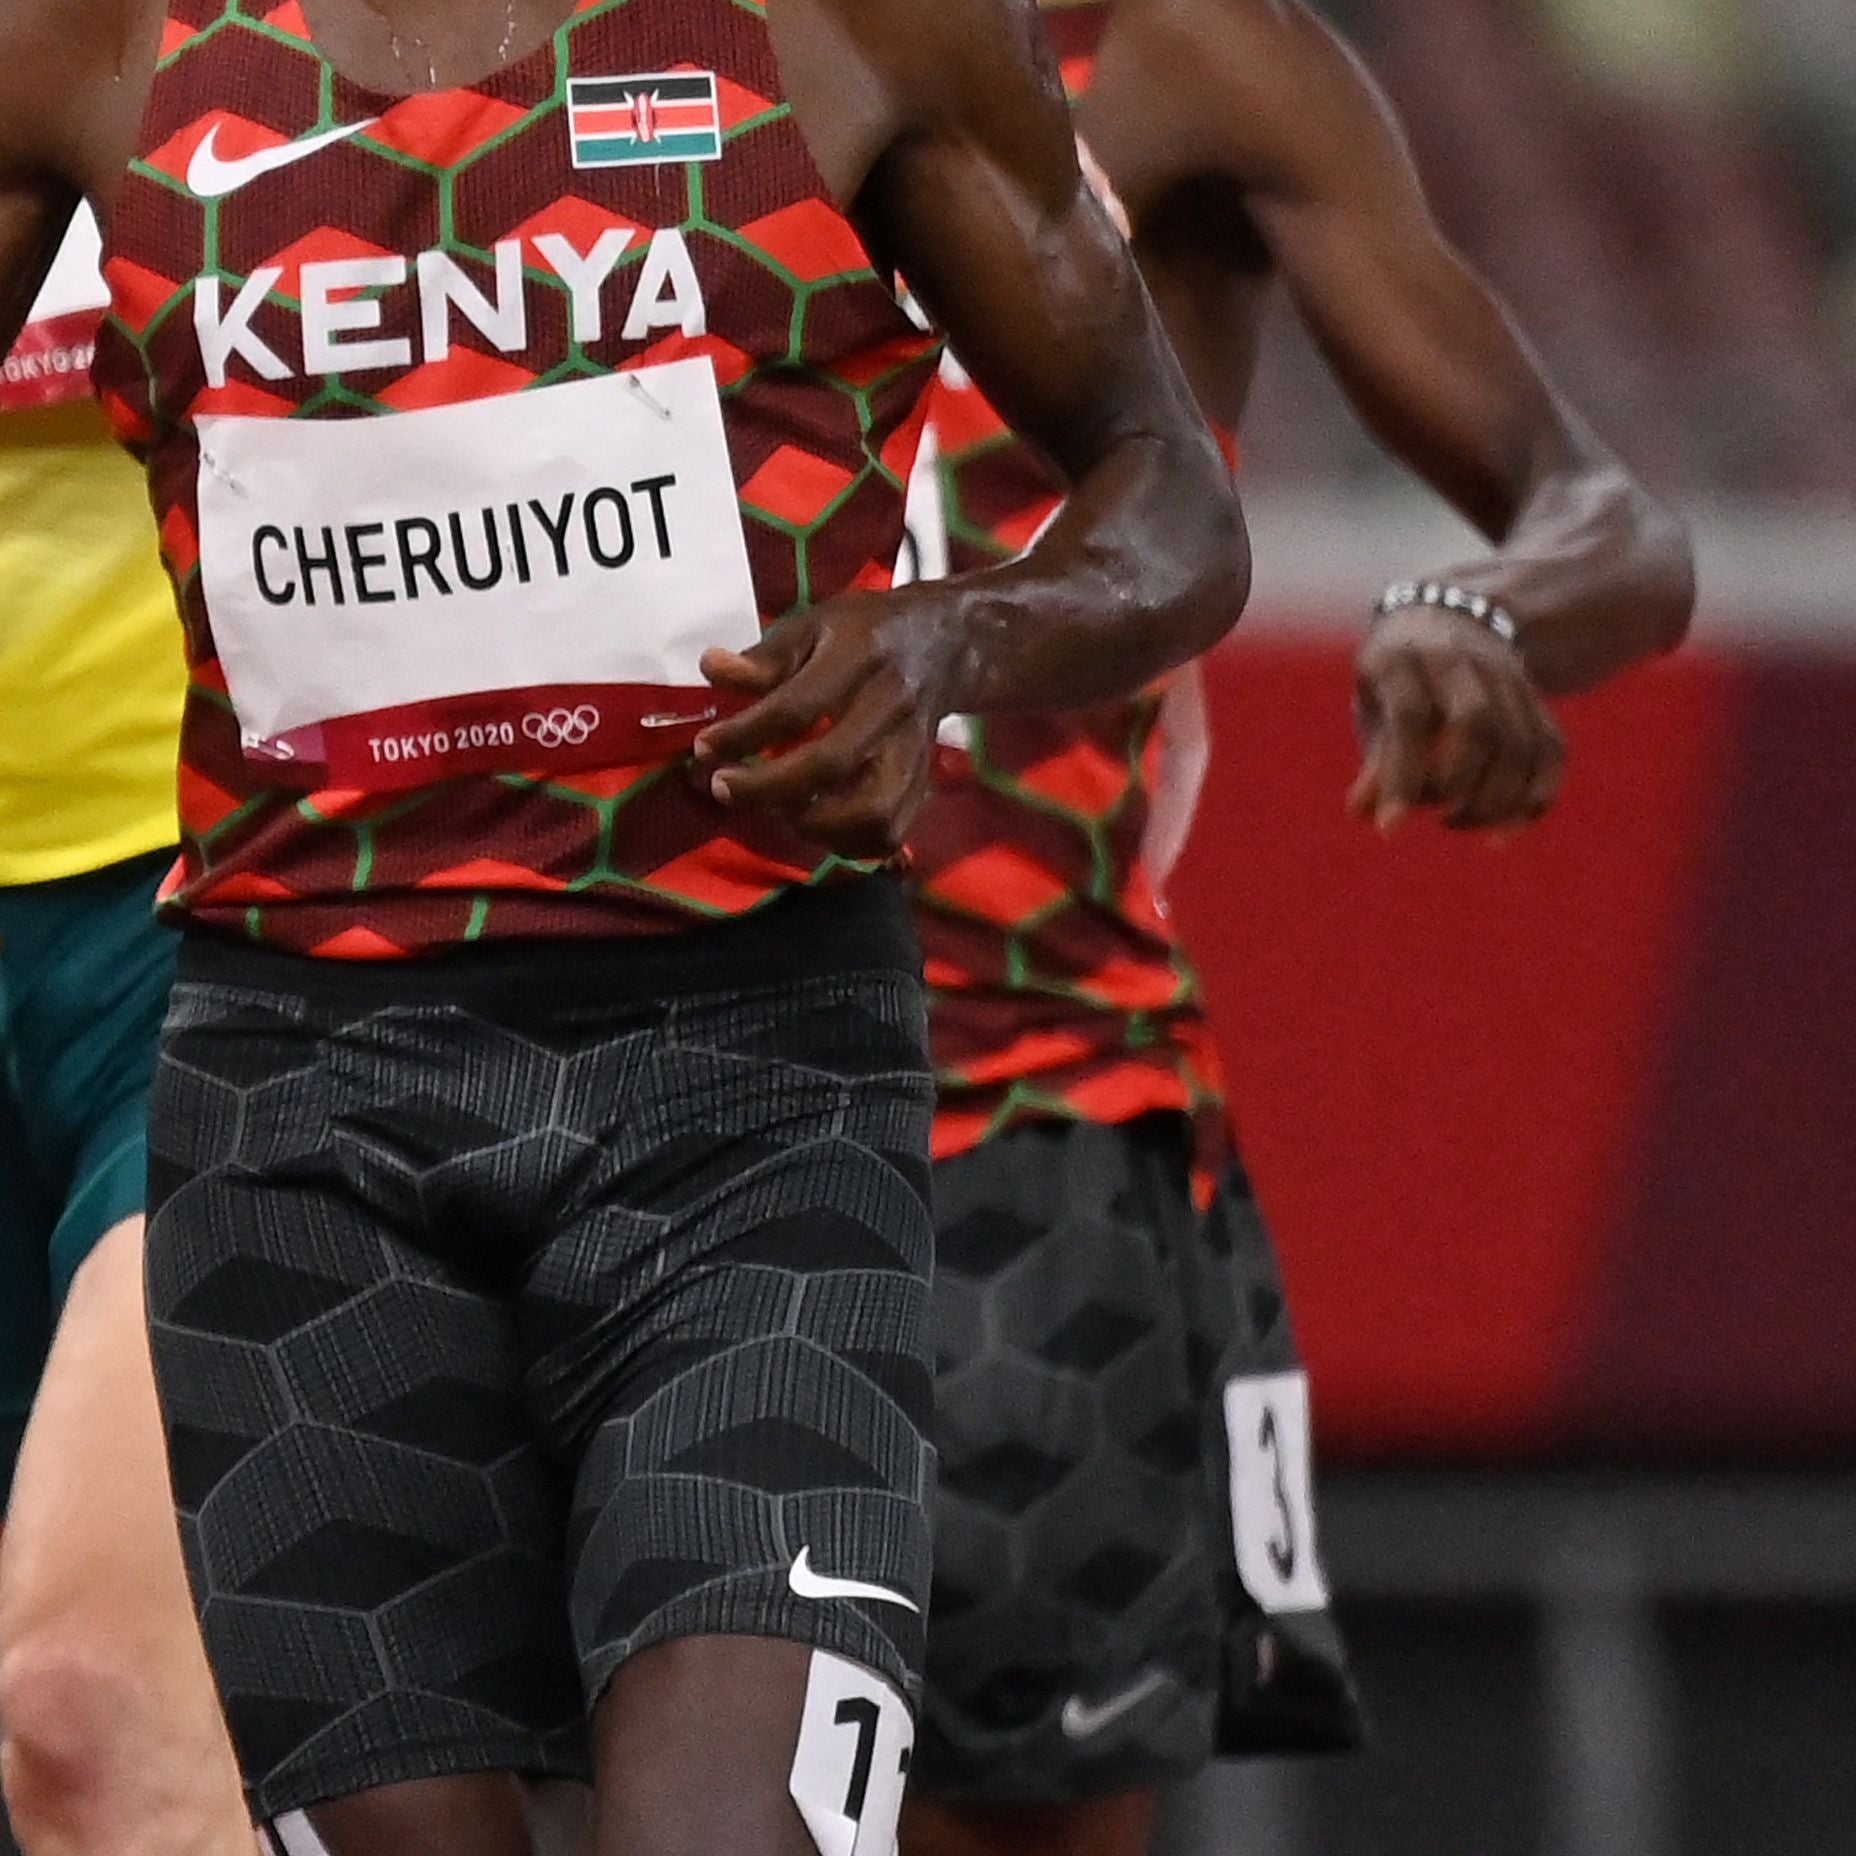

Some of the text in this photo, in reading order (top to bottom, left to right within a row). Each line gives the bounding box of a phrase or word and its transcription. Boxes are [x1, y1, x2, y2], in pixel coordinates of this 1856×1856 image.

[194, 228, 706, 388] KENYA
[251, 472, 677, 607] CHERUIYOT
[368, 721, 514, 763] TOKYO 2020
